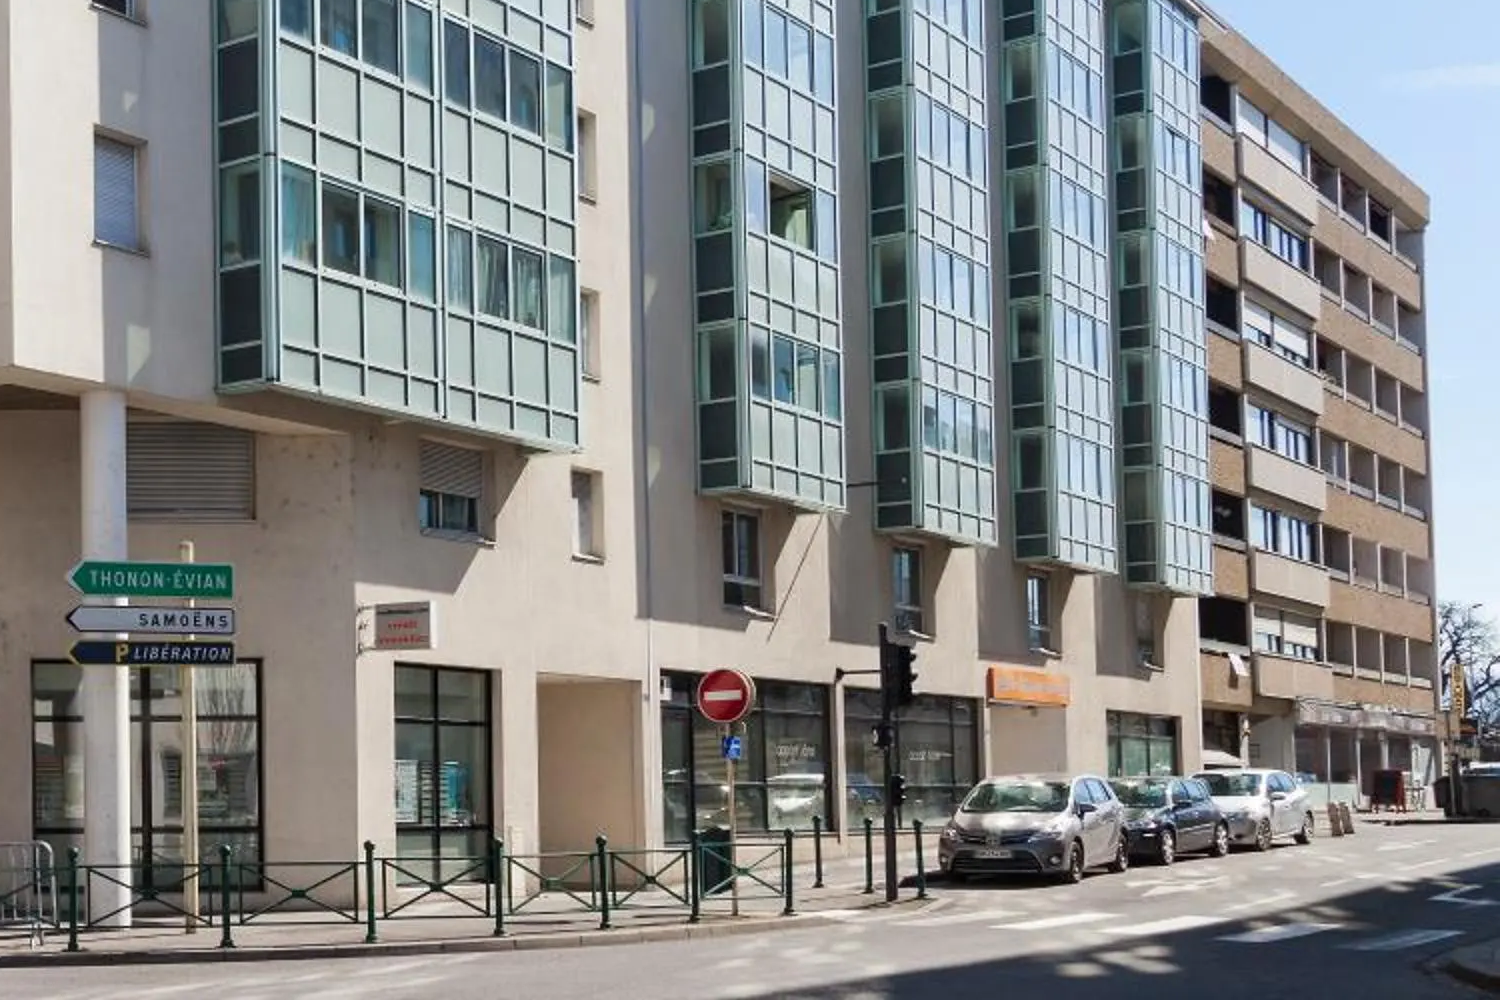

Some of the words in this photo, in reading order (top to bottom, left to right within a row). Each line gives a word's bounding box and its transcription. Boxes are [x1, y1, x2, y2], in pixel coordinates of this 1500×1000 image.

[139, 611, 228, 628] SAMOËNS
[115, 643, 129, 662] P
[133, 642, 231, 661] LIBÉRATION
